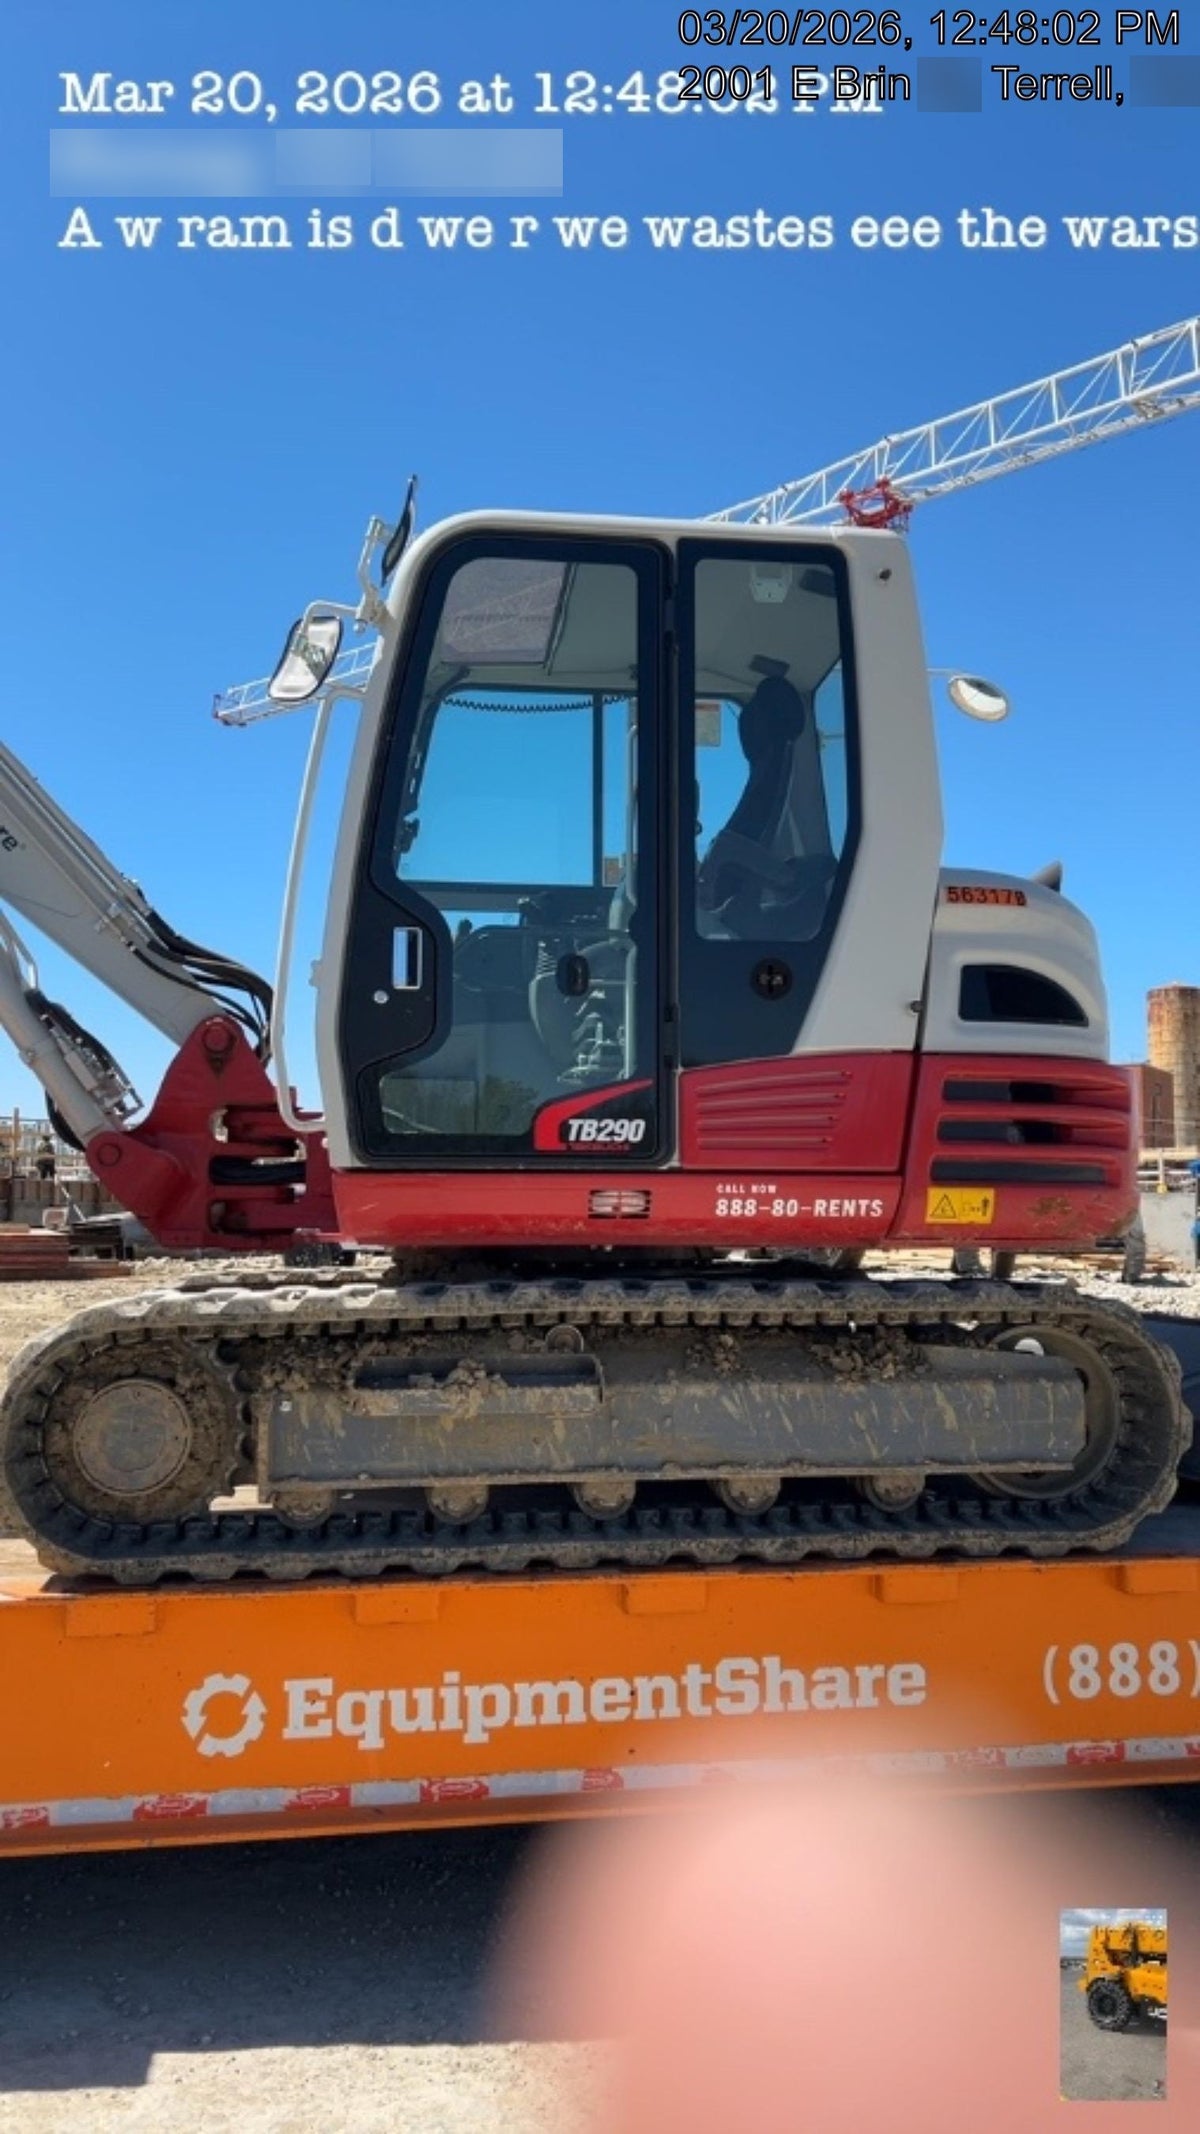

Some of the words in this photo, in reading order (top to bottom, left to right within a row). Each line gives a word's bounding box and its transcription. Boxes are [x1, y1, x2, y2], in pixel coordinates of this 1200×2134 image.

[568, 1118, 647, 1143] TB290
[716, 1183, 746, 1194] CALL
[751, 1184, 777, 1194] NOW
[715, 1198, 884, 1217] 888-80-RENTS
[1043, 1640, 1200, 1705] (888)
[282, 1655, 927, 1751] EquipmentShare
